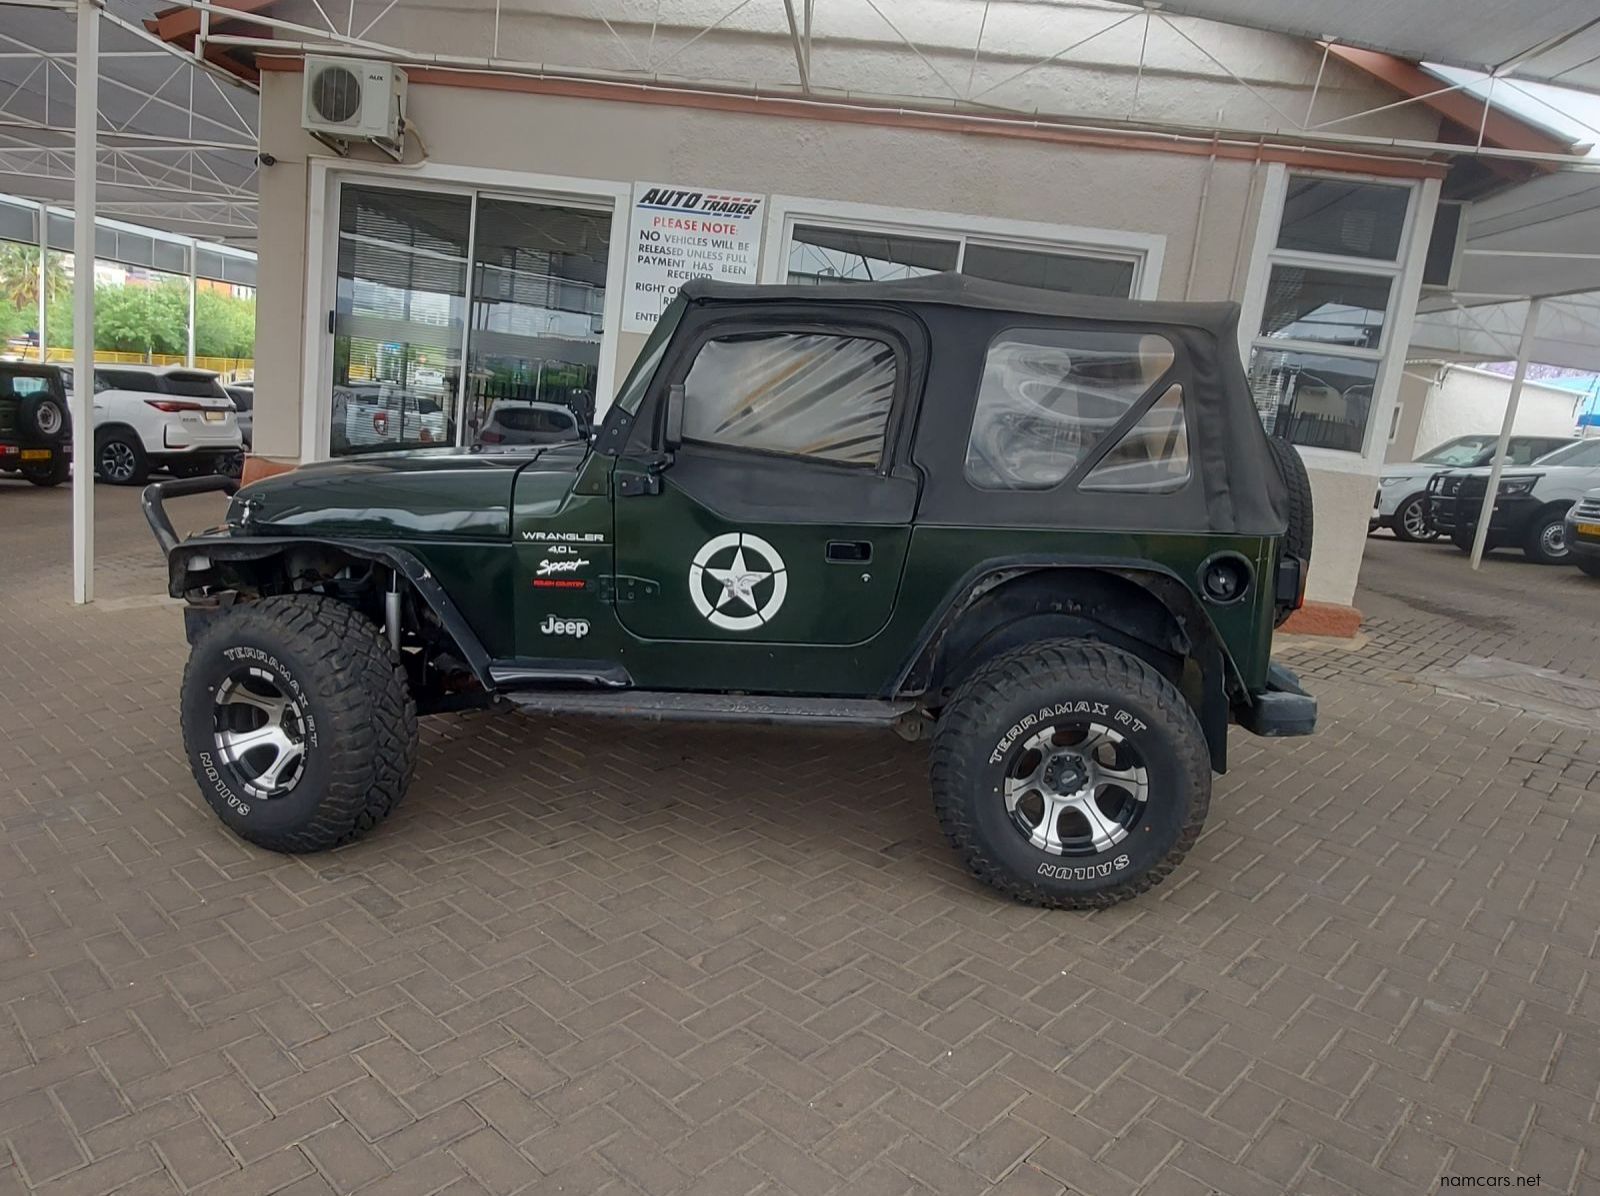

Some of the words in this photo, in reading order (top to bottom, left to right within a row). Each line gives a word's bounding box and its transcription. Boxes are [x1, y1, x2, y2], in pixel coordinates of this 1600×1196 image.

[639, 188, 703, 209] AUTO
[701, 200, 757, 215] TRADER
[653, 216, 697, 231] PLEASE
[640, 230, 661, 242] NO
[664, 234, 708, 247] VEHICLES
[711, 239, 734, 250] WILL
[738, 242, 750, 251] BE
[638, 243, 683, 256] RELEASED
[686, 249, 723, 261] UNLESS
[726, 254, 748, 263] FULL
[637, 255, 686, 268] PAYMENT
[693, 261, 714, 271] HAS
[721, 265, 747, 275] BEEN
[635, 282, 665, 293] RIGHT
[522, 531, 604, 542] WRANGLER
[568, 546, 578, 554] L
[541, 616, 589, 638] Jeep
[223, 646, 309, 709] TERRAMAX
[306, 715, 318, 748] RT
[989, 701, 1110, 765] TERRAMAX
[1114, 709, 1148, 732] RT
[200, 752, 250, 816] SAILUN
[1037, 854, 1130, 880] SAILUN
